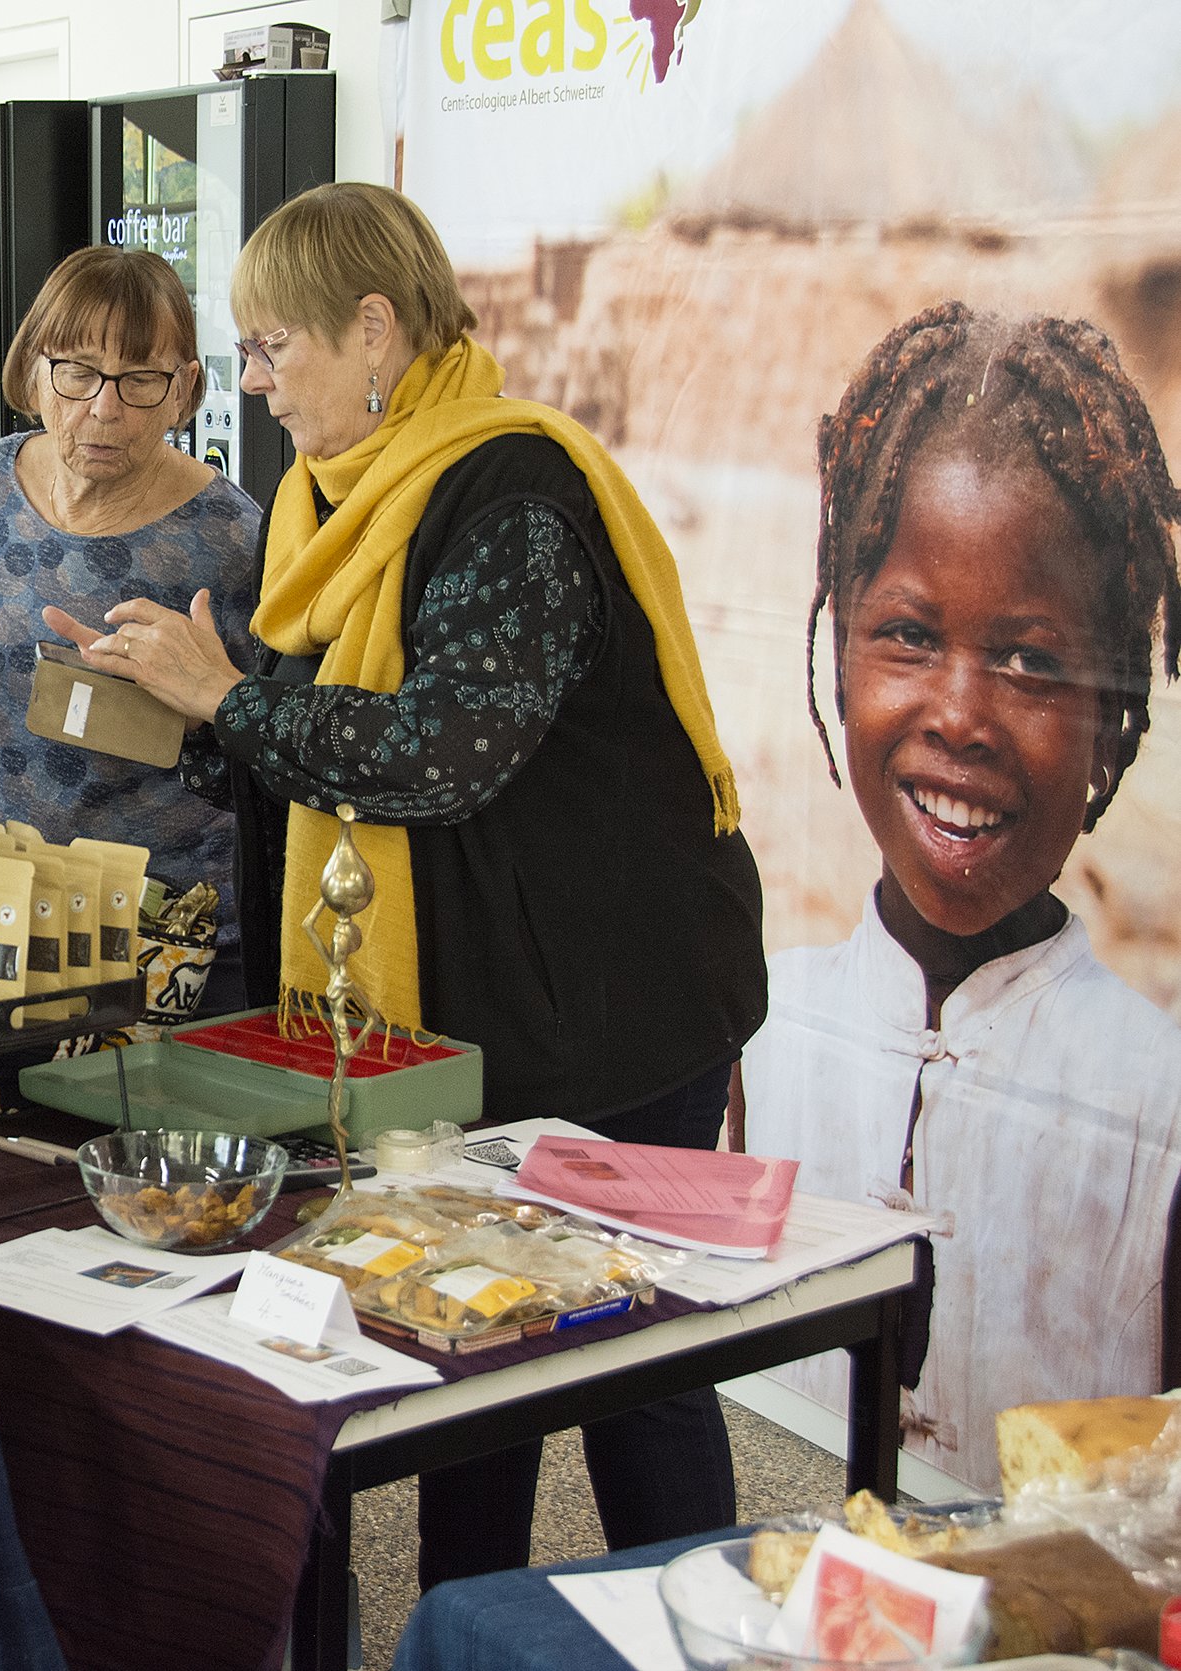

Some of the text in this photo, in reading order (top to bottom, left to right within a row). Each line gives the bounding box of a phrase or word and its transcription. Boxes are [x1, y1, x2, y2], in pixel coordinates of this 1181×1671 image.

[440, 0, 608, 84] ceas
[519, 89, 551, 105] Albert
[553, 84, 605, 103] Schweitzer
[107, 207, 189, 245] coffee bar
